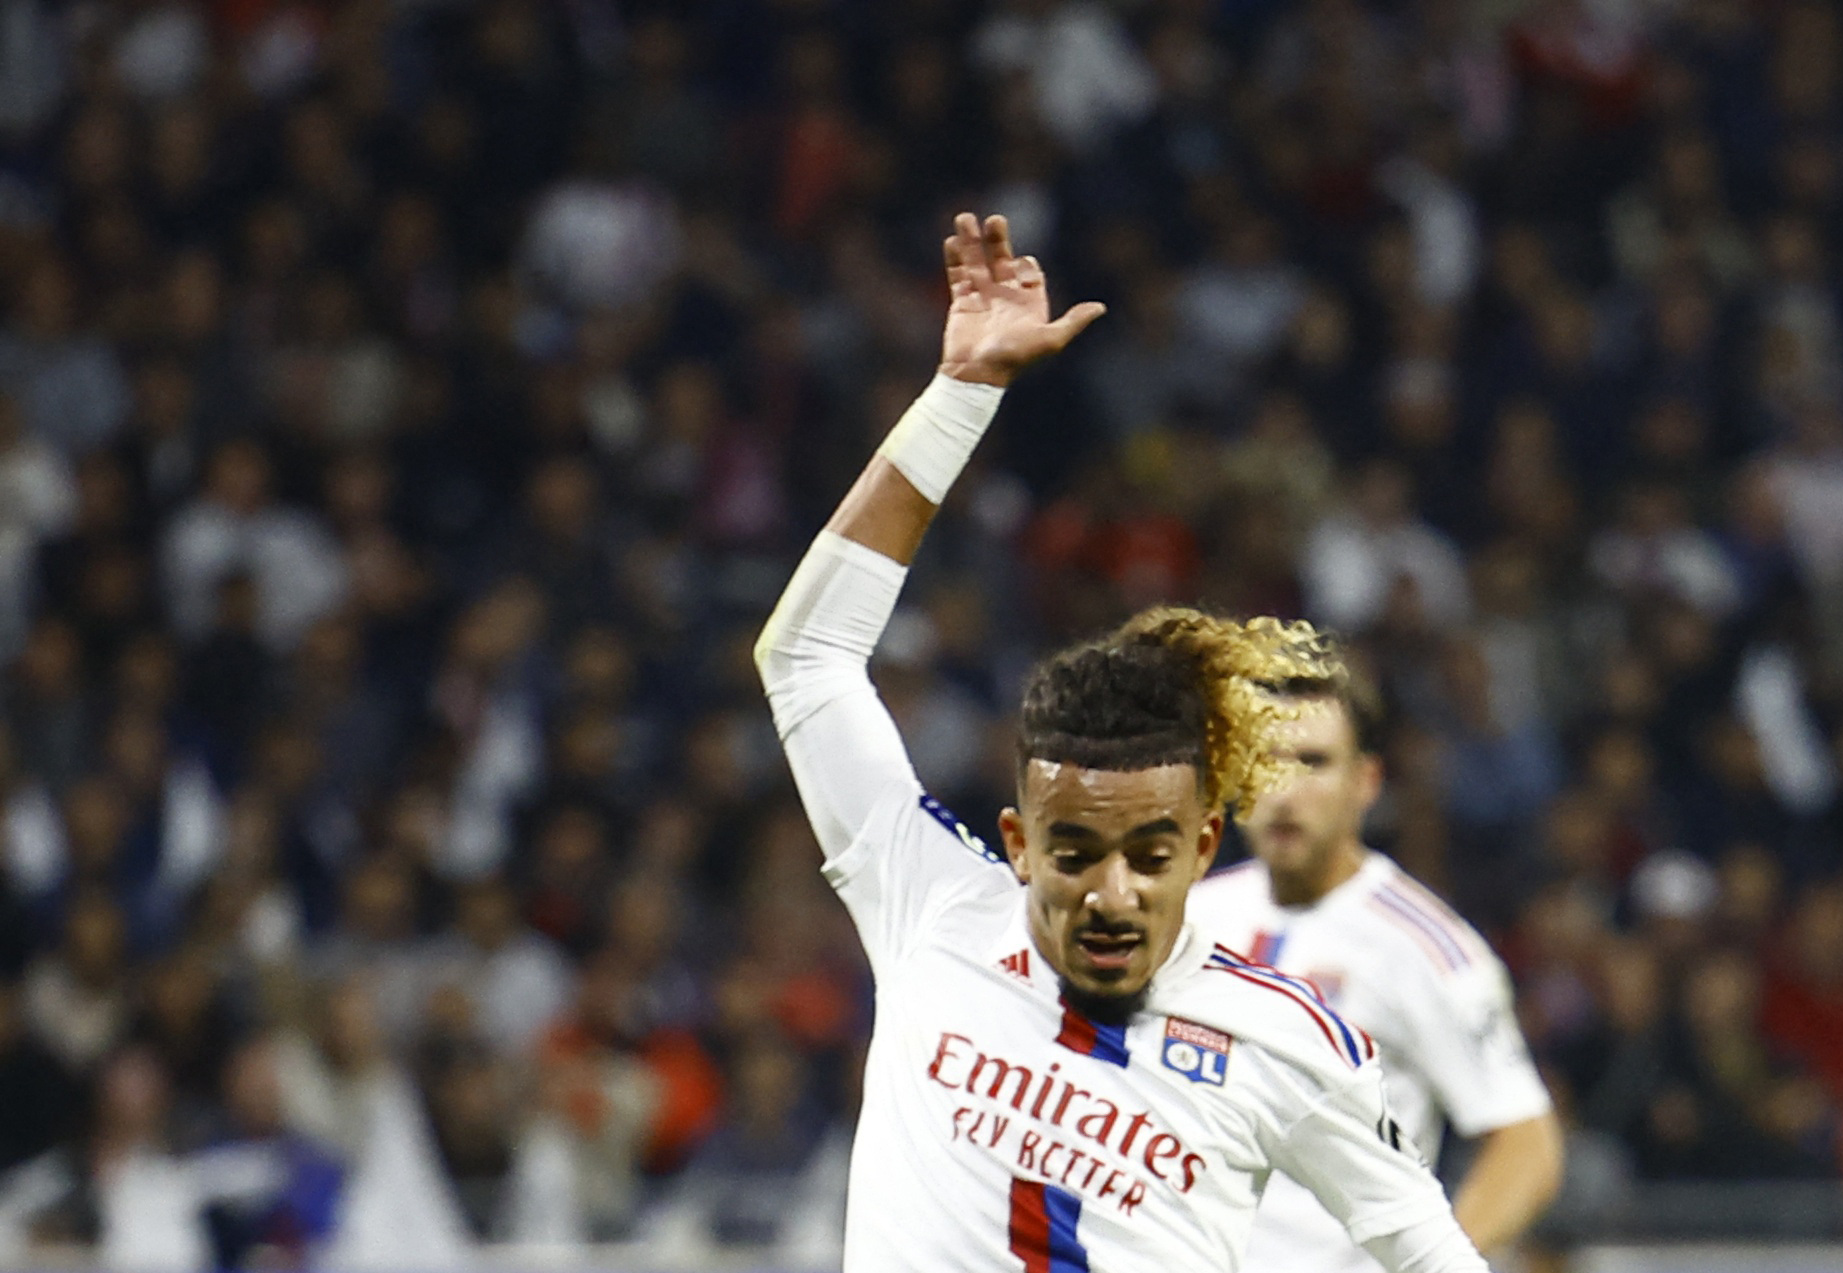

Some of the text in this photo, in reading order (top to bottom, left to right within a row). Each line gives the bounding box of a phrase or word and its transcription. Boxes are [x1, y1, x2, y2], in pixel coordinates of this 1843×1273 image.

[926, 1031, 1207, 1194] Emirates
[1166, 1042, 1224, 1083] OL
[951, 1106, 1147, 1217] FLY BETTER
